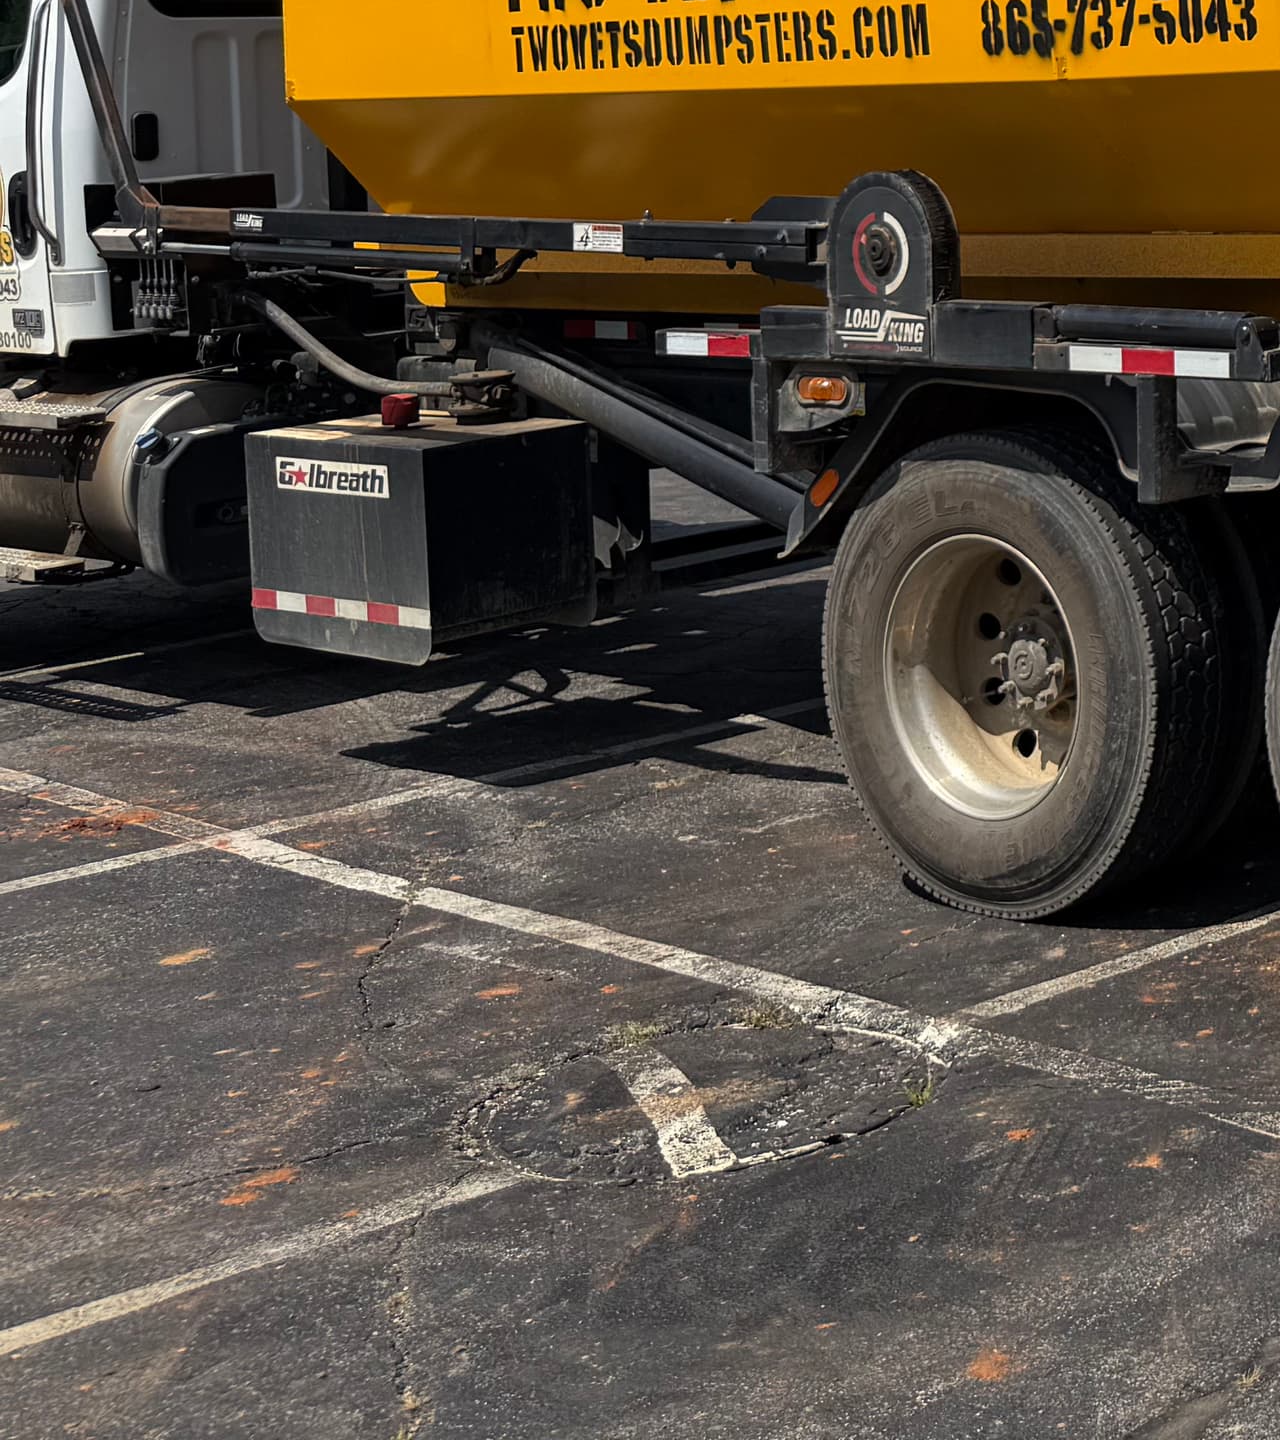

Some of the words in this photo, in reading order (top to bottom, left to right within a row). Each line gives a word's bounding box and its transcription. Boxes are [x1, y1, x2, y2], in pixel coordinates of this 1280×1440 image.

[511, 3, 931, 73] TWOVETSDUMPSTERS.COM
[0, 231, 15, 266] S
[845, 308, 881, 329] LOAD
[888, 320, 925, 343] KING
[279, 461, 384, 494] Glbreath
